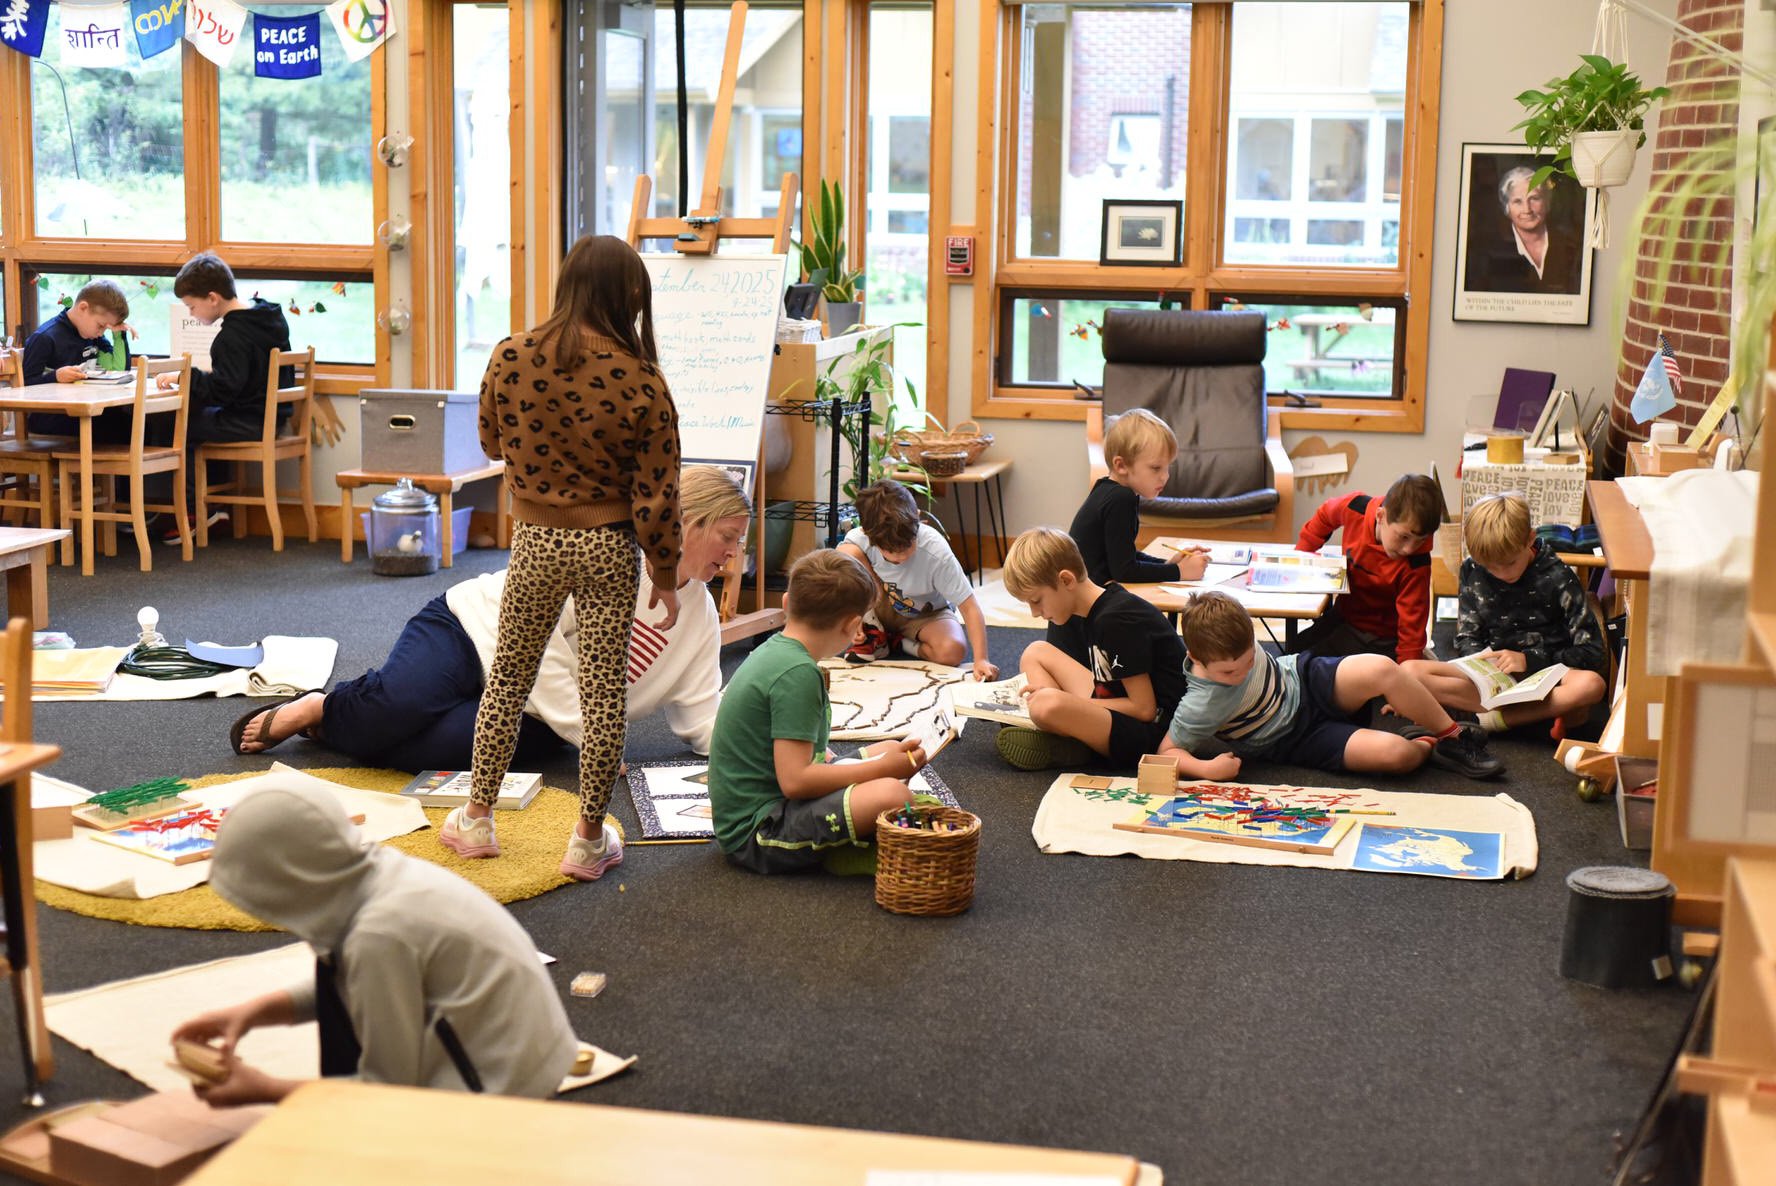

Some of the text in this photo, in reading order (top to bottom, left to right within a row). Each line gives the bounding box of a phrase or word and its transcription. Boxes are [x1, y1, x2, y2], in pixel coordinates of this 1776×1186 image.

[64, 23, 121, 50] शान्ति
[261, 26, 307, 45] PEACE
[257, 45, 318, 65] on Earth
[948, 238, 969, 247] FIRE
[1462, 469, 1500, 484] PEACE
[1546, 478, 1584, 492] PEACE
